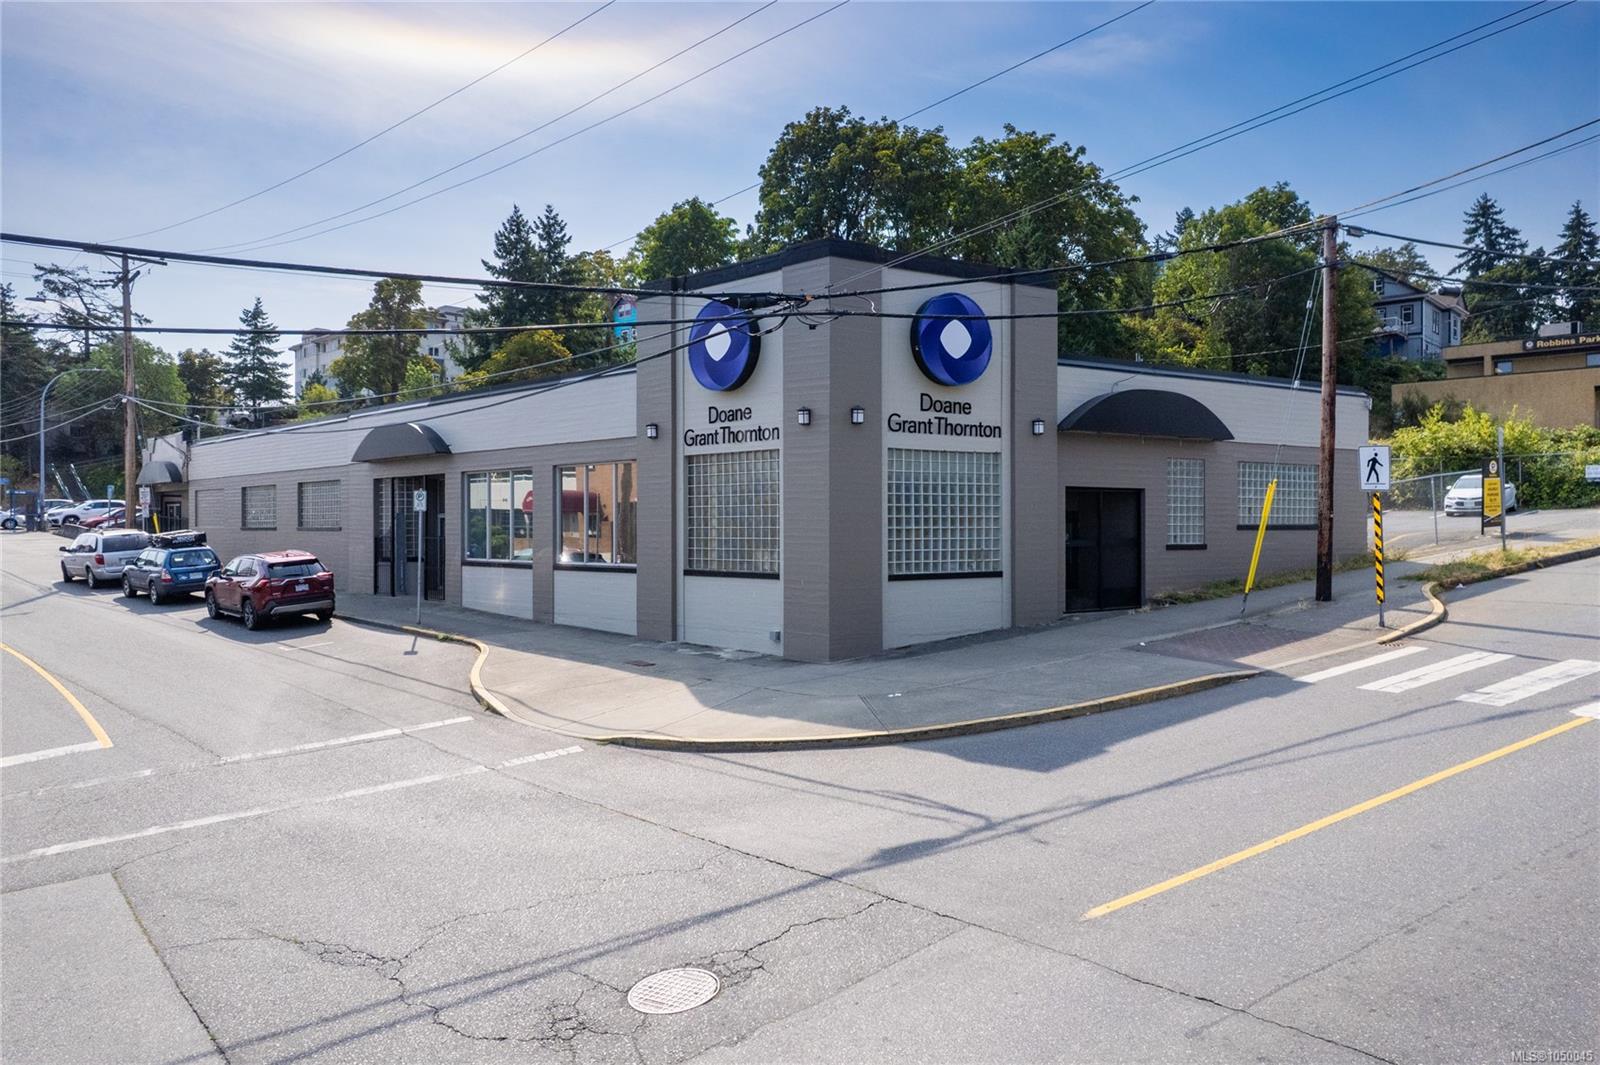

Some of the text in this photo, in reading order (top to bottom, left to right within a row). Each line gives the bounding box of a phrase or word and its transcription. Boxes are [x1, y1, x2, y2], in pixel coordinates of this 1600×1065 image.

[1536, 338, 1576, 348] Robbins
[920, 392, 972, 415] Doane
[708, 406, 752, 424] Doane
